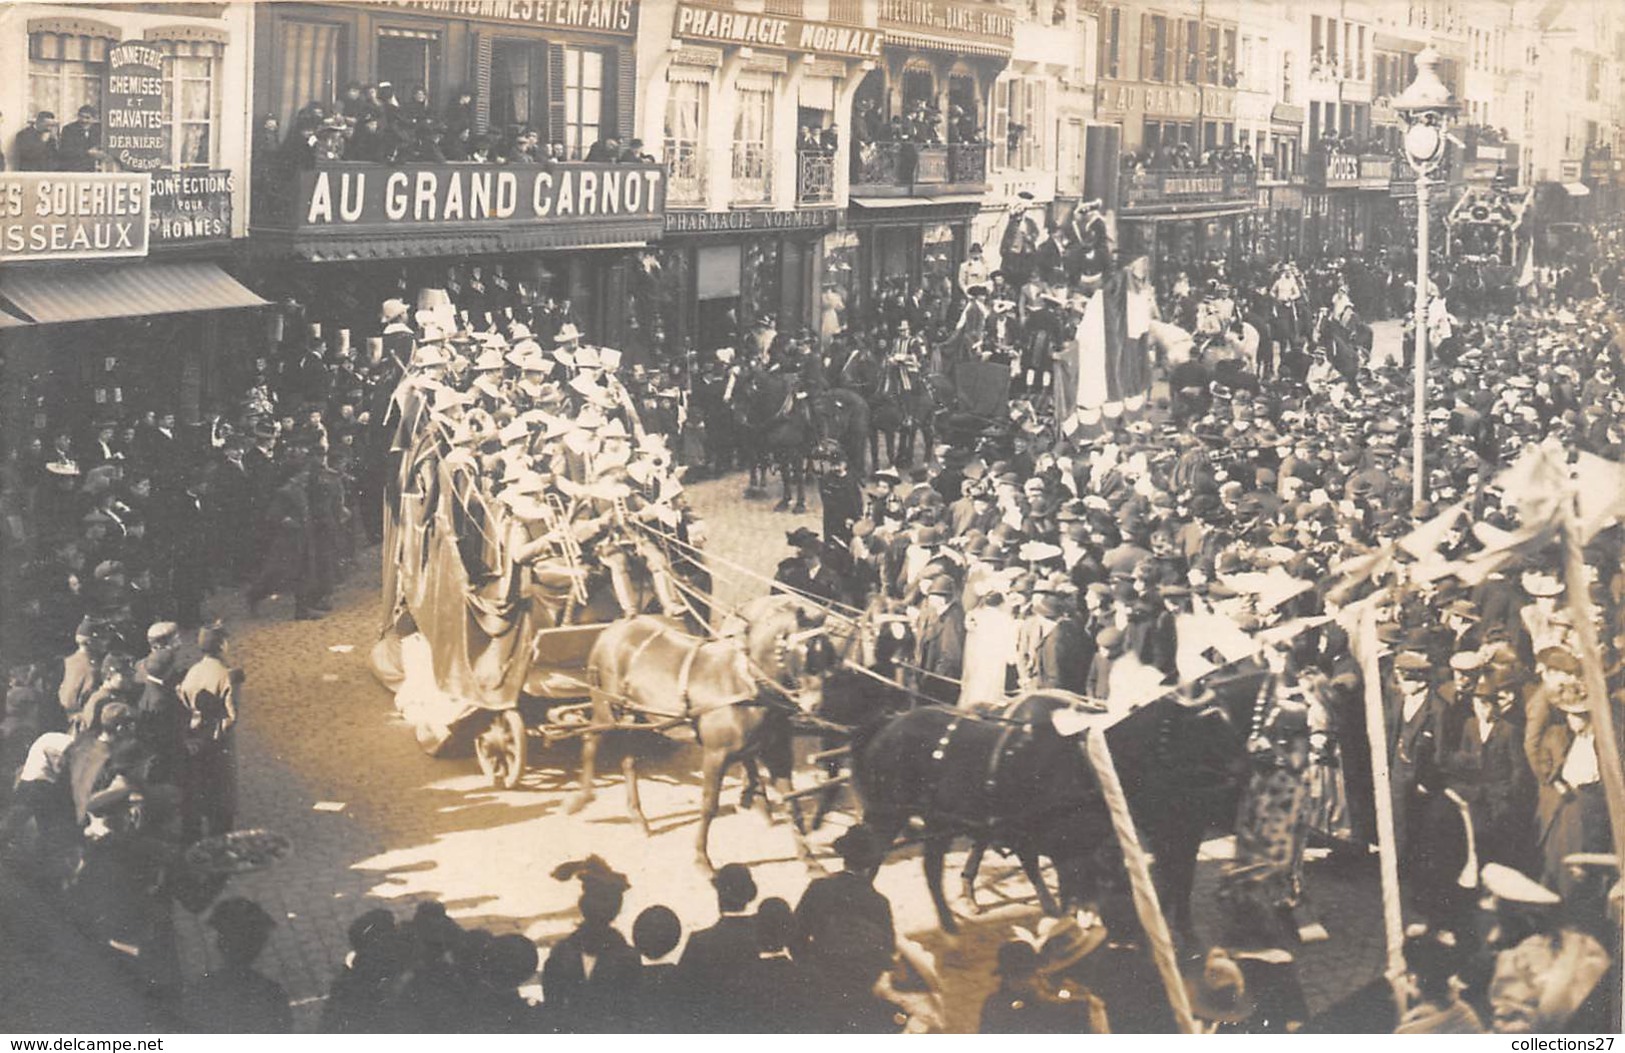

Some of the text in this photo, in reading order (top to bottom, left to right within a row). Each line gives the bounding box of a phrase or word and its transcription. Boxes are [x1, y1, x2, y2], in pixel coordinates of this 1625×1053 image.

[453, 0, 531, 20] HOMMES
[536, 6, 549, 21] ET
[556, 1, 632, 30] ENFANTS
[679, 7, 884, 56] PHARMACIE NORMALE
[109, 46, 162, 70] BONNETERIE
[109, 76, 162, 95] CHEMISES
[127, 98, 143, 107] ET
[109, 109, 162, 129] CRAVATES
[150, 176, 234, 196] CONFECTIONS
[308, 169, 661, 224] AU GRAND CARNOT
[35, 180, 142, 217] SOIERIES
[177, 200, 203, 212] POUR
[162, 219, 222, 238] HOMMES
[666, 210, 830, 231] PHARMACIE NORMALE
[0, 223, 132, 252] SSEAUX
